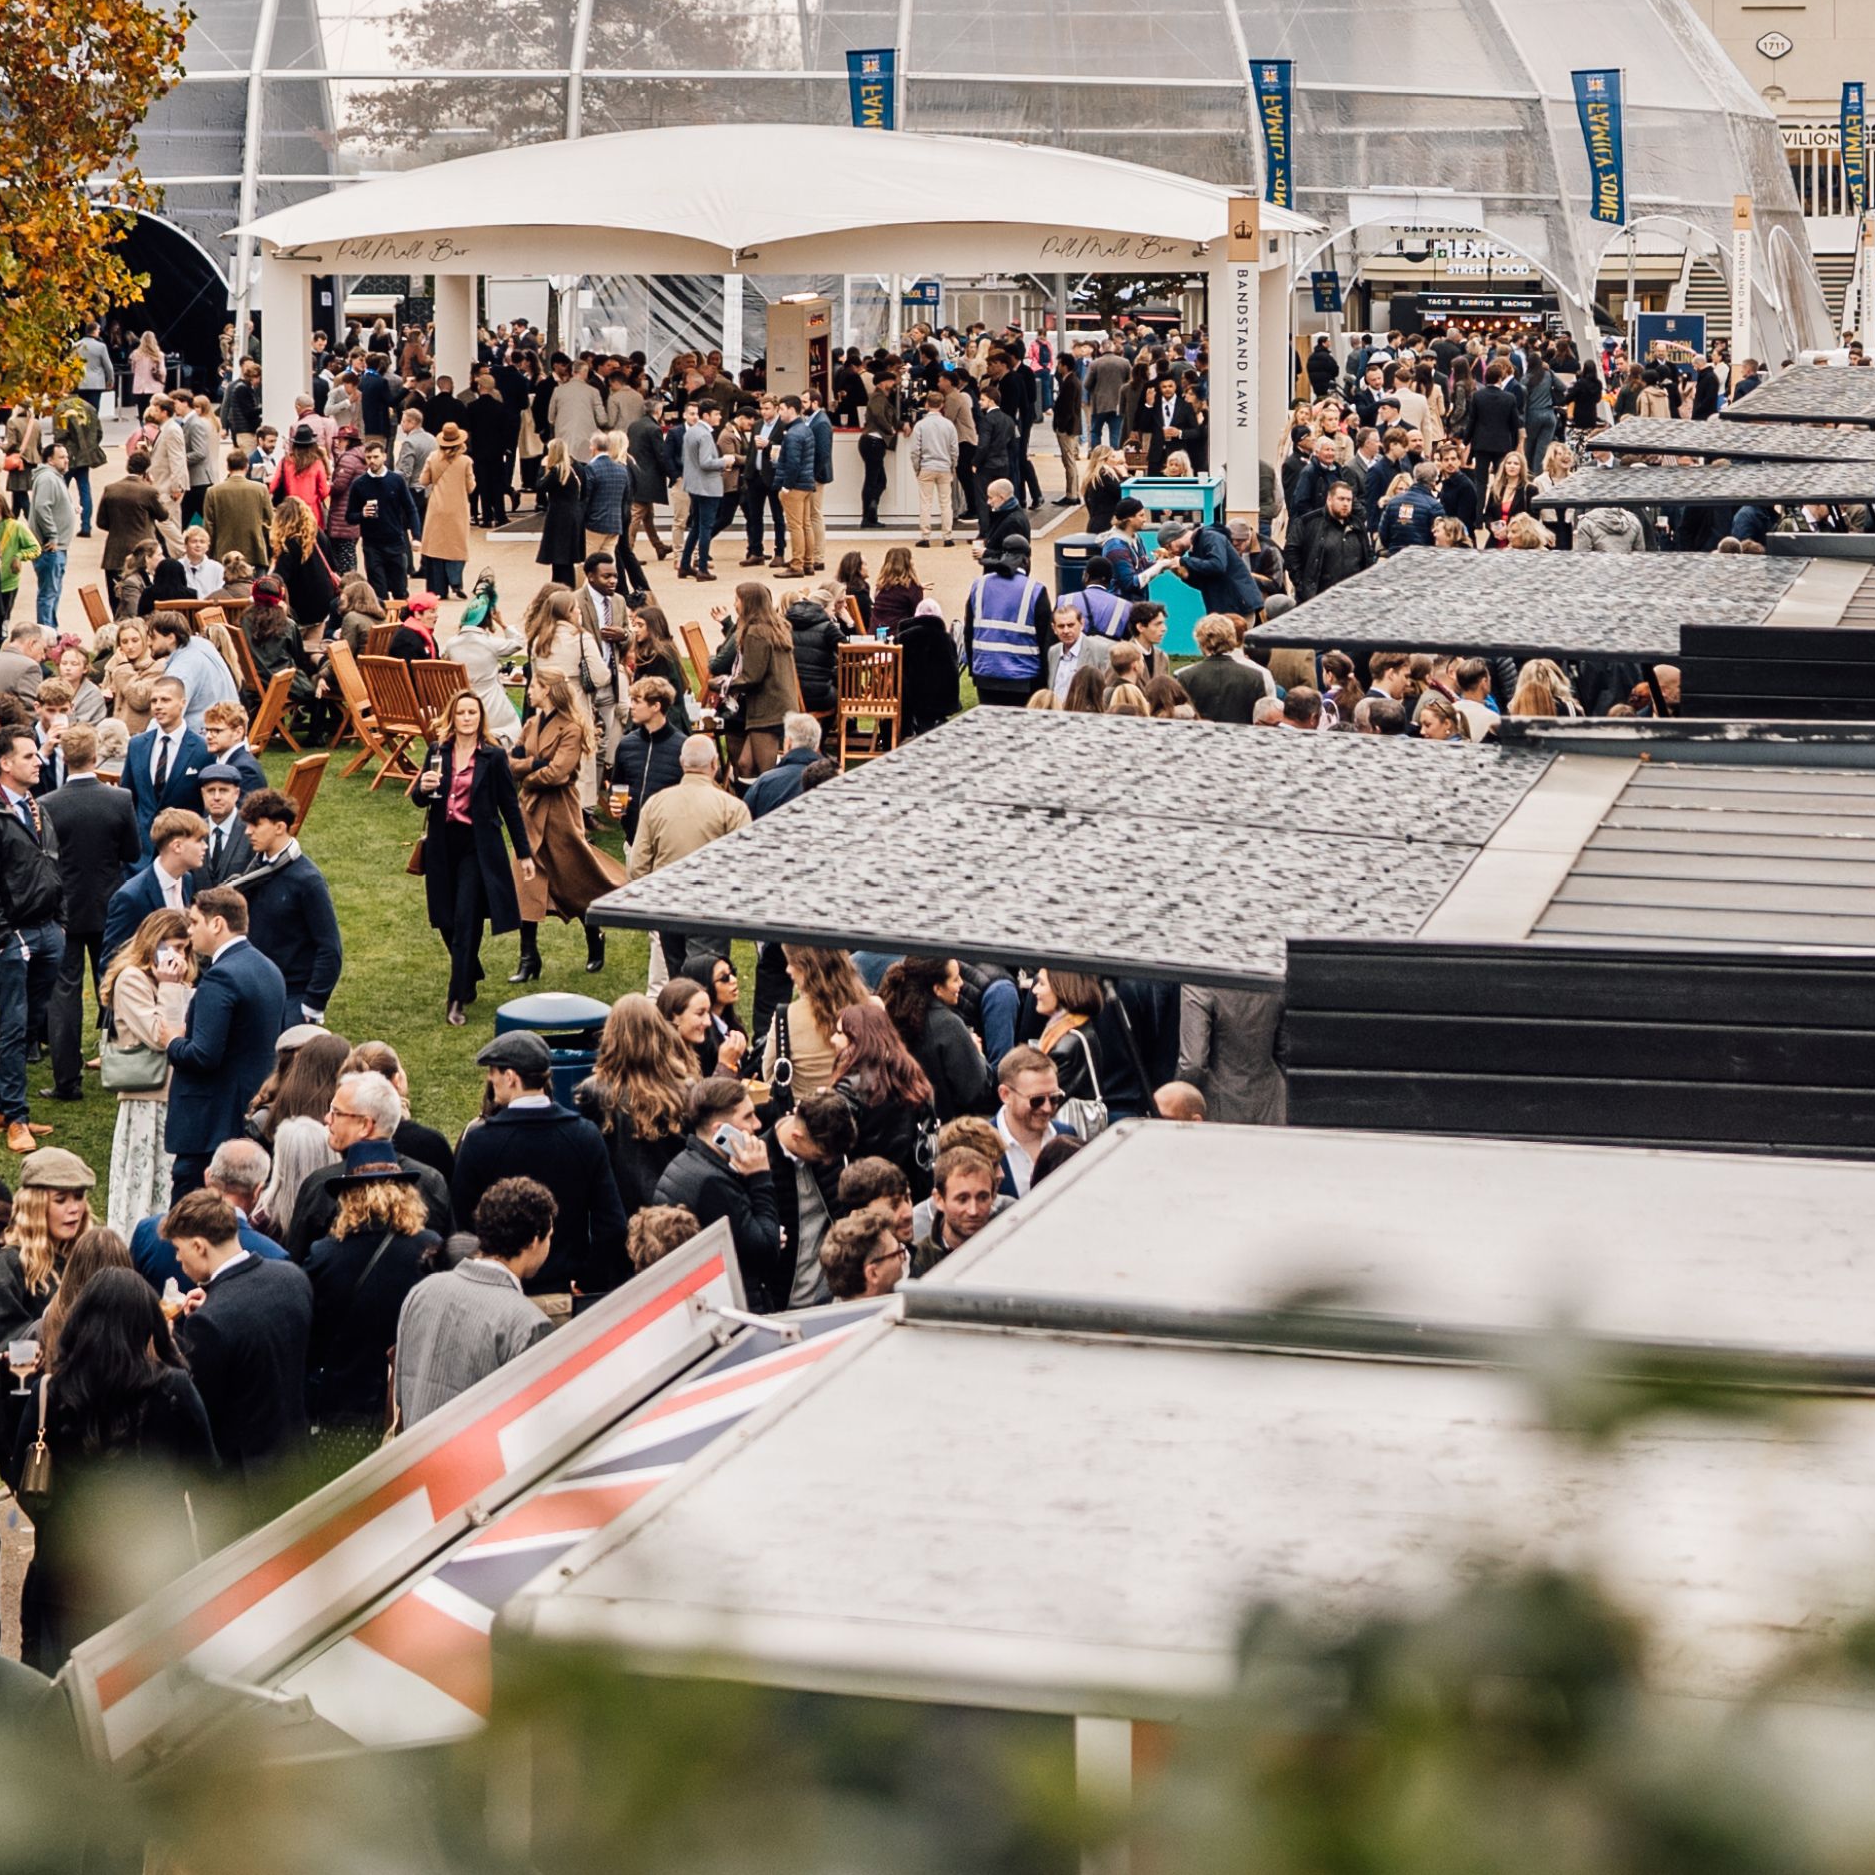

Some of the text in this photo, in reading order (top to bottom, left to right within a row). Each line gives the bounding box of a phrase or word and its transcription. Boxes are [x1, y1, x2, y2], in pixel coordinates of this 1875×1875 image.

[1764, 42, 1785, 51] 1711
[1782, 132, 1839, 145] VILION
[1433, 238, 1520, 259] MEXIC
[1446, 263, 1530, 275] STREET FOOD
[1737, 233, 1746, 327] GRANDSTAND LAWN
[1459, 299, 1495, 307] BURRITOS
[1501, 300, 1533, 308] NACHOS
[1237, 269, 1248, 428] BANDSTAND LAWN
